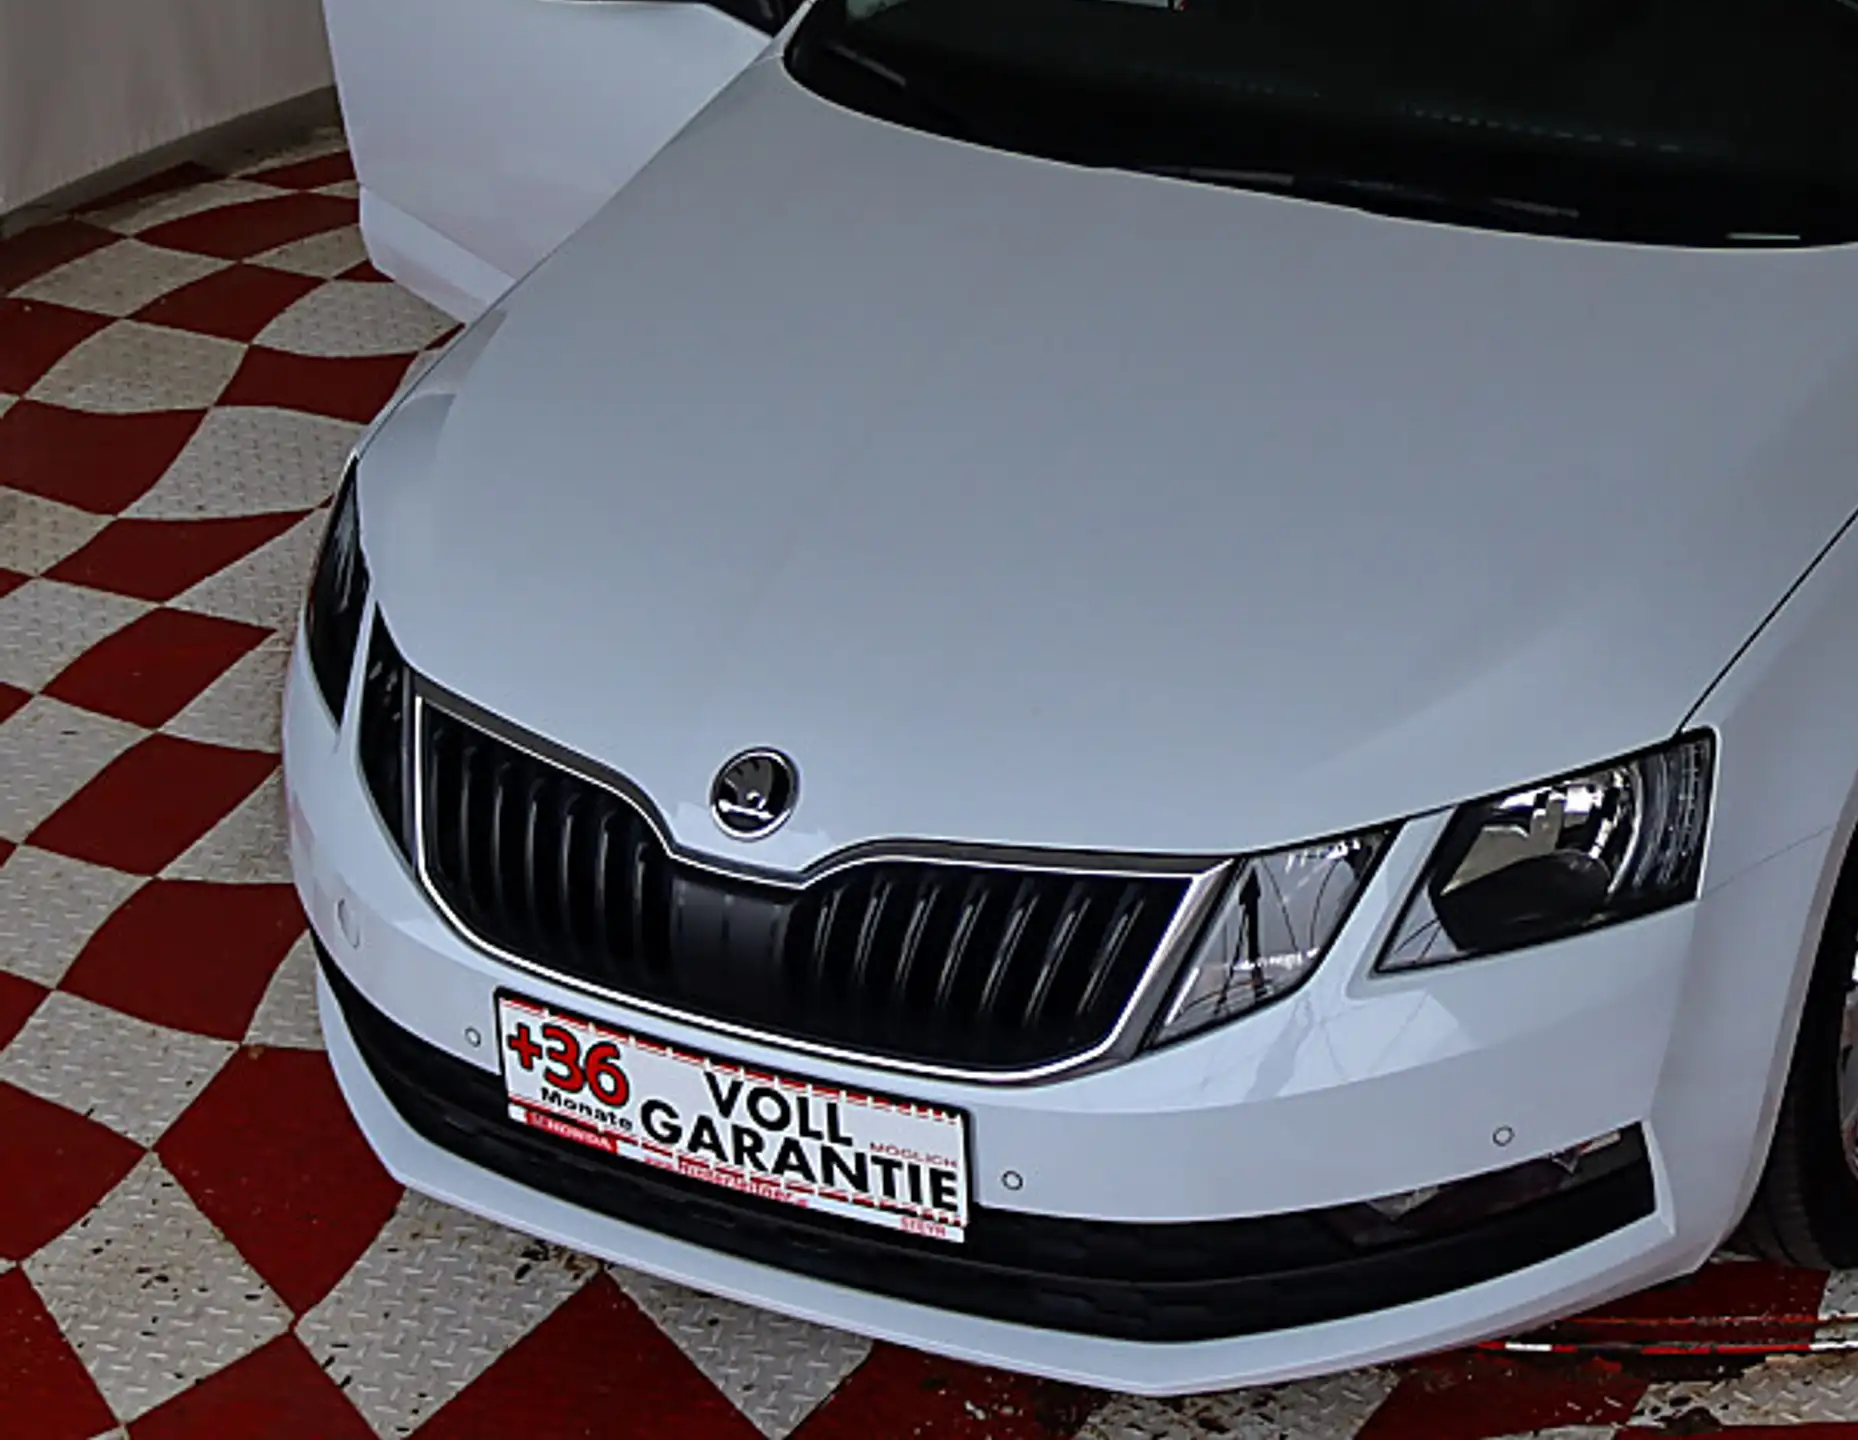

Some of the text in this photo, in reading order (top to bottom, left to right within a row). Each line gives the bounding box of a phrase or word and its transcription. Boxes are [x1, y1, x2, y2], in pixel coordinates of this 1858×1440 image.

[506, 1021, 631, 1108] +36
[539, 1086, 634, 1132] Monate
[703, 1071, 854, 1147] VOLL
[640, 1098, 959, 1213] GARANTIE
